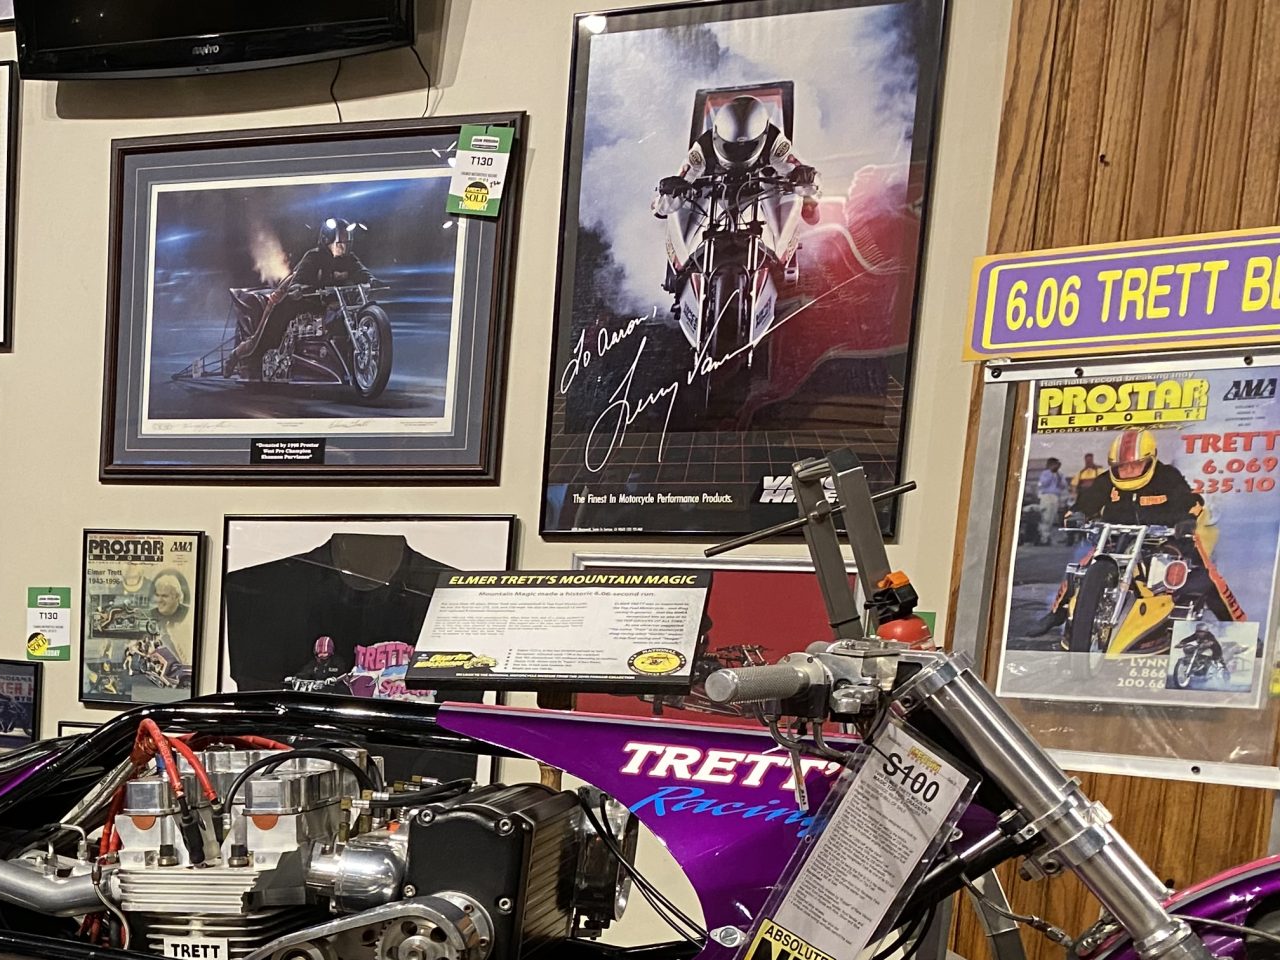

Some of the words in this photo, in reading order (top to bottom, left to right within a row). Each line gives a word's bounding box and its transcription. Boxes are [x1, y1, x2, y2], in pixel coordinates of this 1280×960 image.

[471, 156, 493, 166] T130
[464, 193, 488, 203] SOLD
[1005, 275, 1081, 331] 6.06
[1097, 259, 1229, 323] TRETT
[1090, 376, 1123, 384] record
[1125, 372, 1169, 382] breaking
[1038, 378, 1210, 416] PROSTAR
[1223, 378, 1278, 401] AMA
[1181, 430, 1280, 454] TRETT
[1202, 457, 1278, 475] 6.069
[1191, 477, 1276, 494] 235.10
[572, 494, 586, 504] The
[587, 494, 607, 504] Finest
[609, 494, 616, 504] In
[619, 493, 655, 505] Motorcycle
[657, 493, 700, 504] Performance
[702, 493, 733, 504] Products.
[89, 540, 164, 555] PROSTAR
[170, 542, 192, 552] AMA
[448, 576, 498, 585] ELMER
[500, 575, 558, 585] TRETT'S
[559, 575, 643, 585] MOUNTAIN
[644, 575, 697, 584] MAGIC
[1130, 657, 1168, 667] LYNN
[883, 753, 940, 803] S100
[171, 943, 220, 959] TRETT
